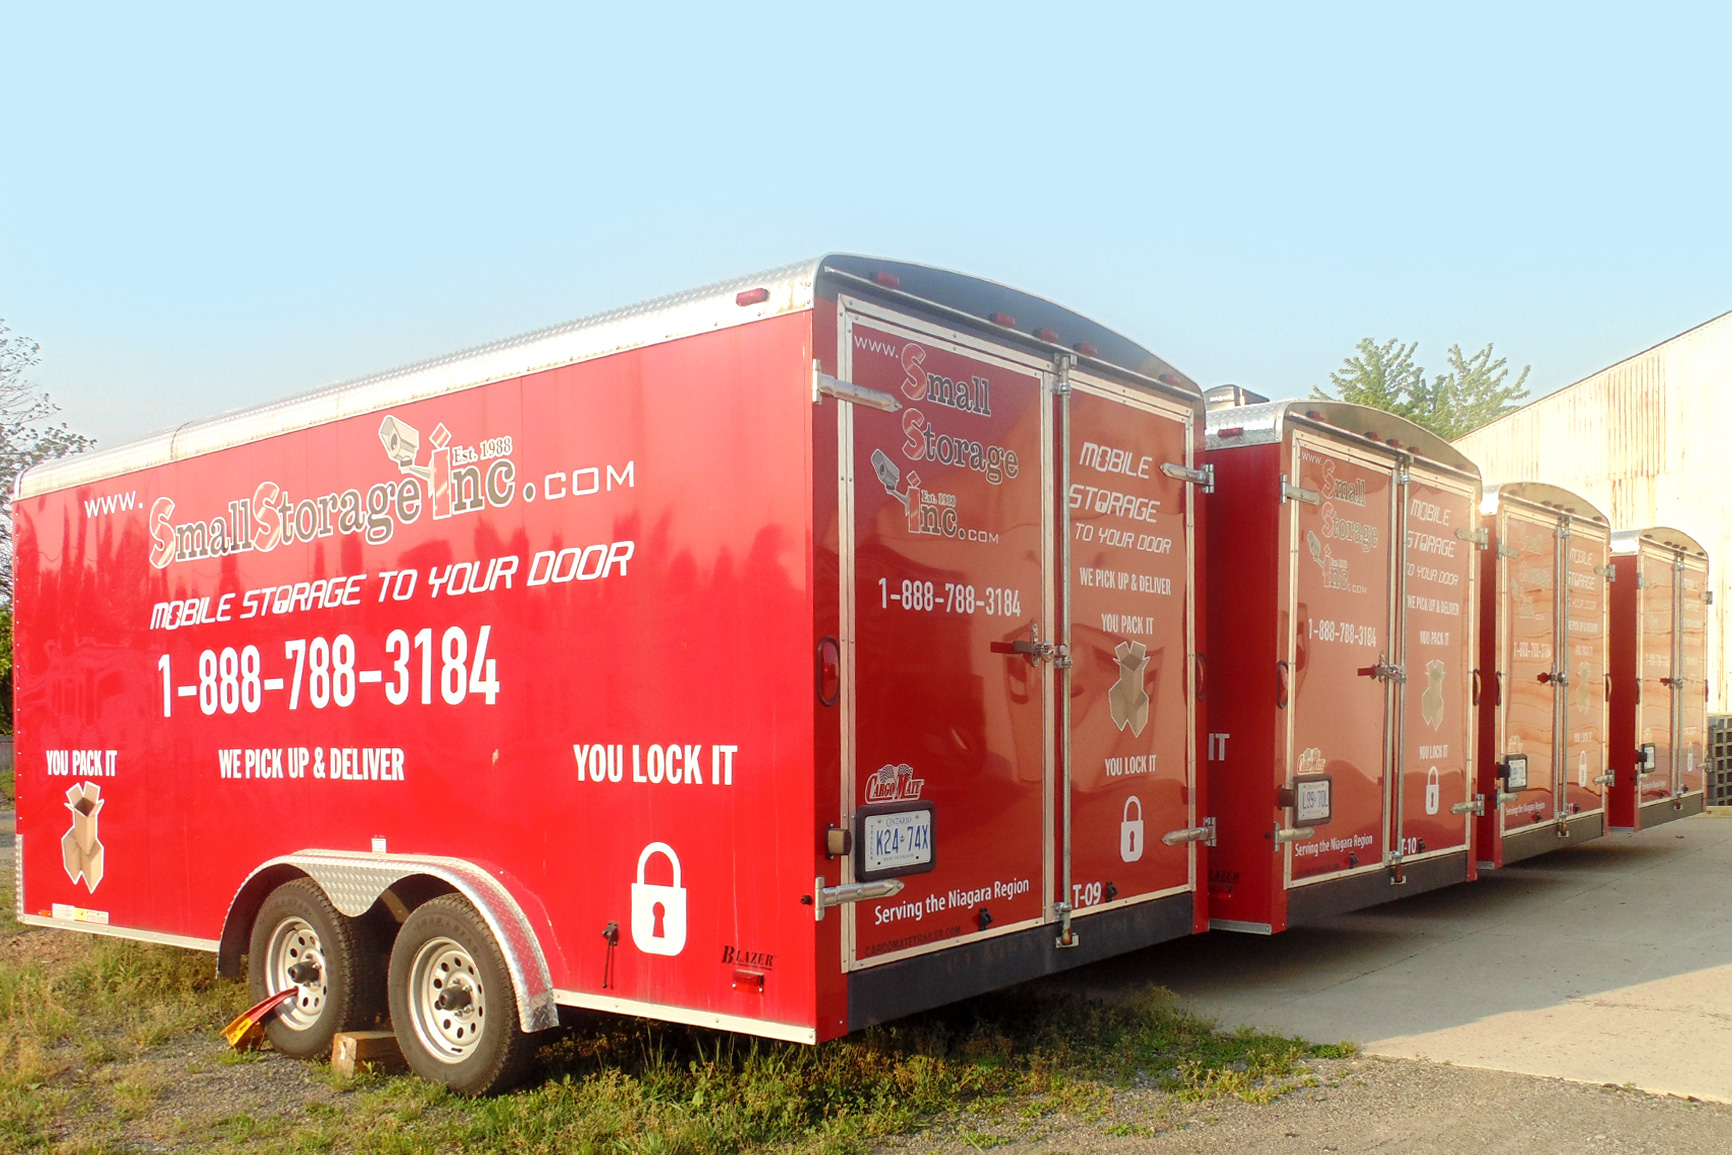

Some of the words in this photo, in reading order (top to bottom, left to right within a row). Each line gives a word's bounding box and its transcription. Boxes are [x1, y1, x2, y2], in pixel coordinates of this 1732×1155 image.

[452, 444, 478, 466] Est.
[480, 436, 512, 460] 1988
[902, 408, 1019, 485] Storage
[1079, 442, 1153, 479] MOBILE
[1069, 483, 1160, 523] STORAGE
[1410, 499, 1452, 526] MOBILE
[1075, 523, 1095, 541] TO
[1098, 527, 1134, 549] YOUR
[1137, 534, 1172, 554] DOOR
[1321, 501, 1378, 553] Storage
[1407, 530, 1456, 558] STORAGE
[150, 593, 236, 630] MOBILE
[240, 574, 367, 618] STORAGE
[378, 569, 417, 603] TO
[428, 555, 519, 598] YOUR
[526, 540, 635, 587] DOOR
[1079, 567, 1093, 587] WE
[1095, 569, 1116, 589] PICK
[1118, 572, 1129, 590] UP
[1130, 574, 1138, 591] &
[1139, 575, 1172, 596] DELIVER
[1417, 565, 1438, 582] YOUR
[1438, 570, 1459, 586] DOOR
[878, 578, 1022, 617] 1-888-788-3184
[1101, 614, 1118, 633] YOU
[1121, 614, 1144, 634] PACK
[1146, 617, 1155, 635] IT
[1308, 618, 1377, 648] 1-888-788-3184
[157, 625, 501, 718] 1-888-788-3184
[1208, 733, 1230, 761] IT
[46, 749, 68, 776] YOU
[72, 749, 103, 776] PACK
[105, 750, 118, 776] IT
[218, 749, 241, 778] WE
[245, 749, 283, 778] PICK
[288, 748, 309, 778] UP
[313, 748, 326, 778] &
[330, 747, 405, 781] DELIVER
[573, 744, 623, 782] YOU
[632, 744, 703, 785] LOCK
[711, 745, 738, 785] IT
[1105, 757, 1122, 776] YOU
[1125, 755, 1147, 775] LOCK
[1149, 754, 1157, 773] IT
[1295, 842, 1319, 857] Serving
[1319, 839, 1330, 853] the
[1330, 838, 1353, 852] Niagara
[1354, 833, 1373, 849] Region
[874, 899, 923, 925] Serving
[925, 893, 946, 914] the
[948, 885, 992, 910] Niagara
[994, 877, 1030, 900] Region
[1072, 881, 1102, 908] T-09
[721, 945, 774, 967] BLAZER
